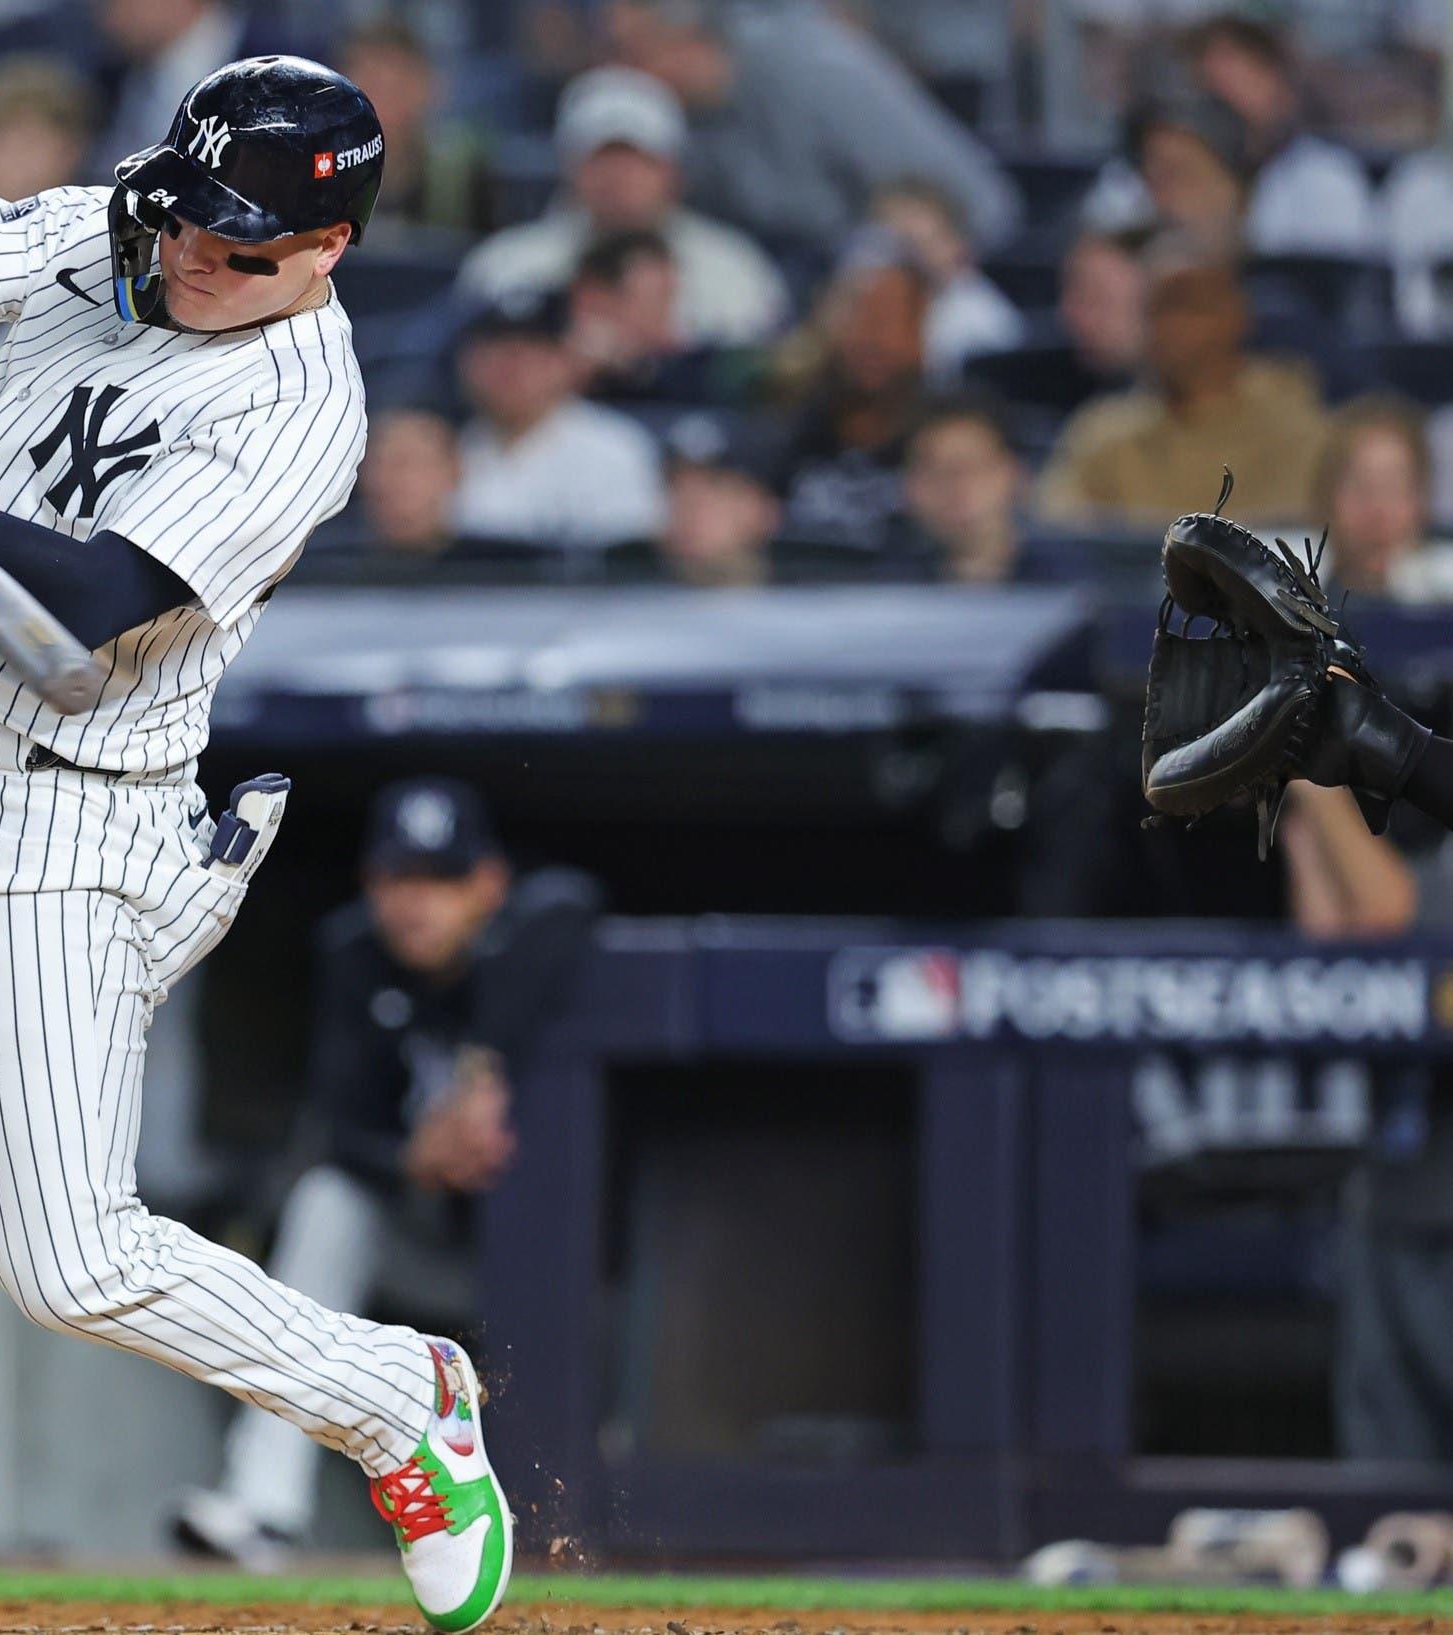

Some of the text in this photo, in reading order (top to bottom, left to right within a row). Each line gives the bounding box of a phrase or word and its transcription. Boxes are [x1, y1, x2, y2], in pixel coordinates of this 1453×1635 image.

[188, 115, 232, 169] NY
[336, 134, 383, 171] STRAUSS
[147, 188, 178, 208] 24
[28, 384, 161, 518] NY
[959, 953, 1426, 1040] POSTSEASON
